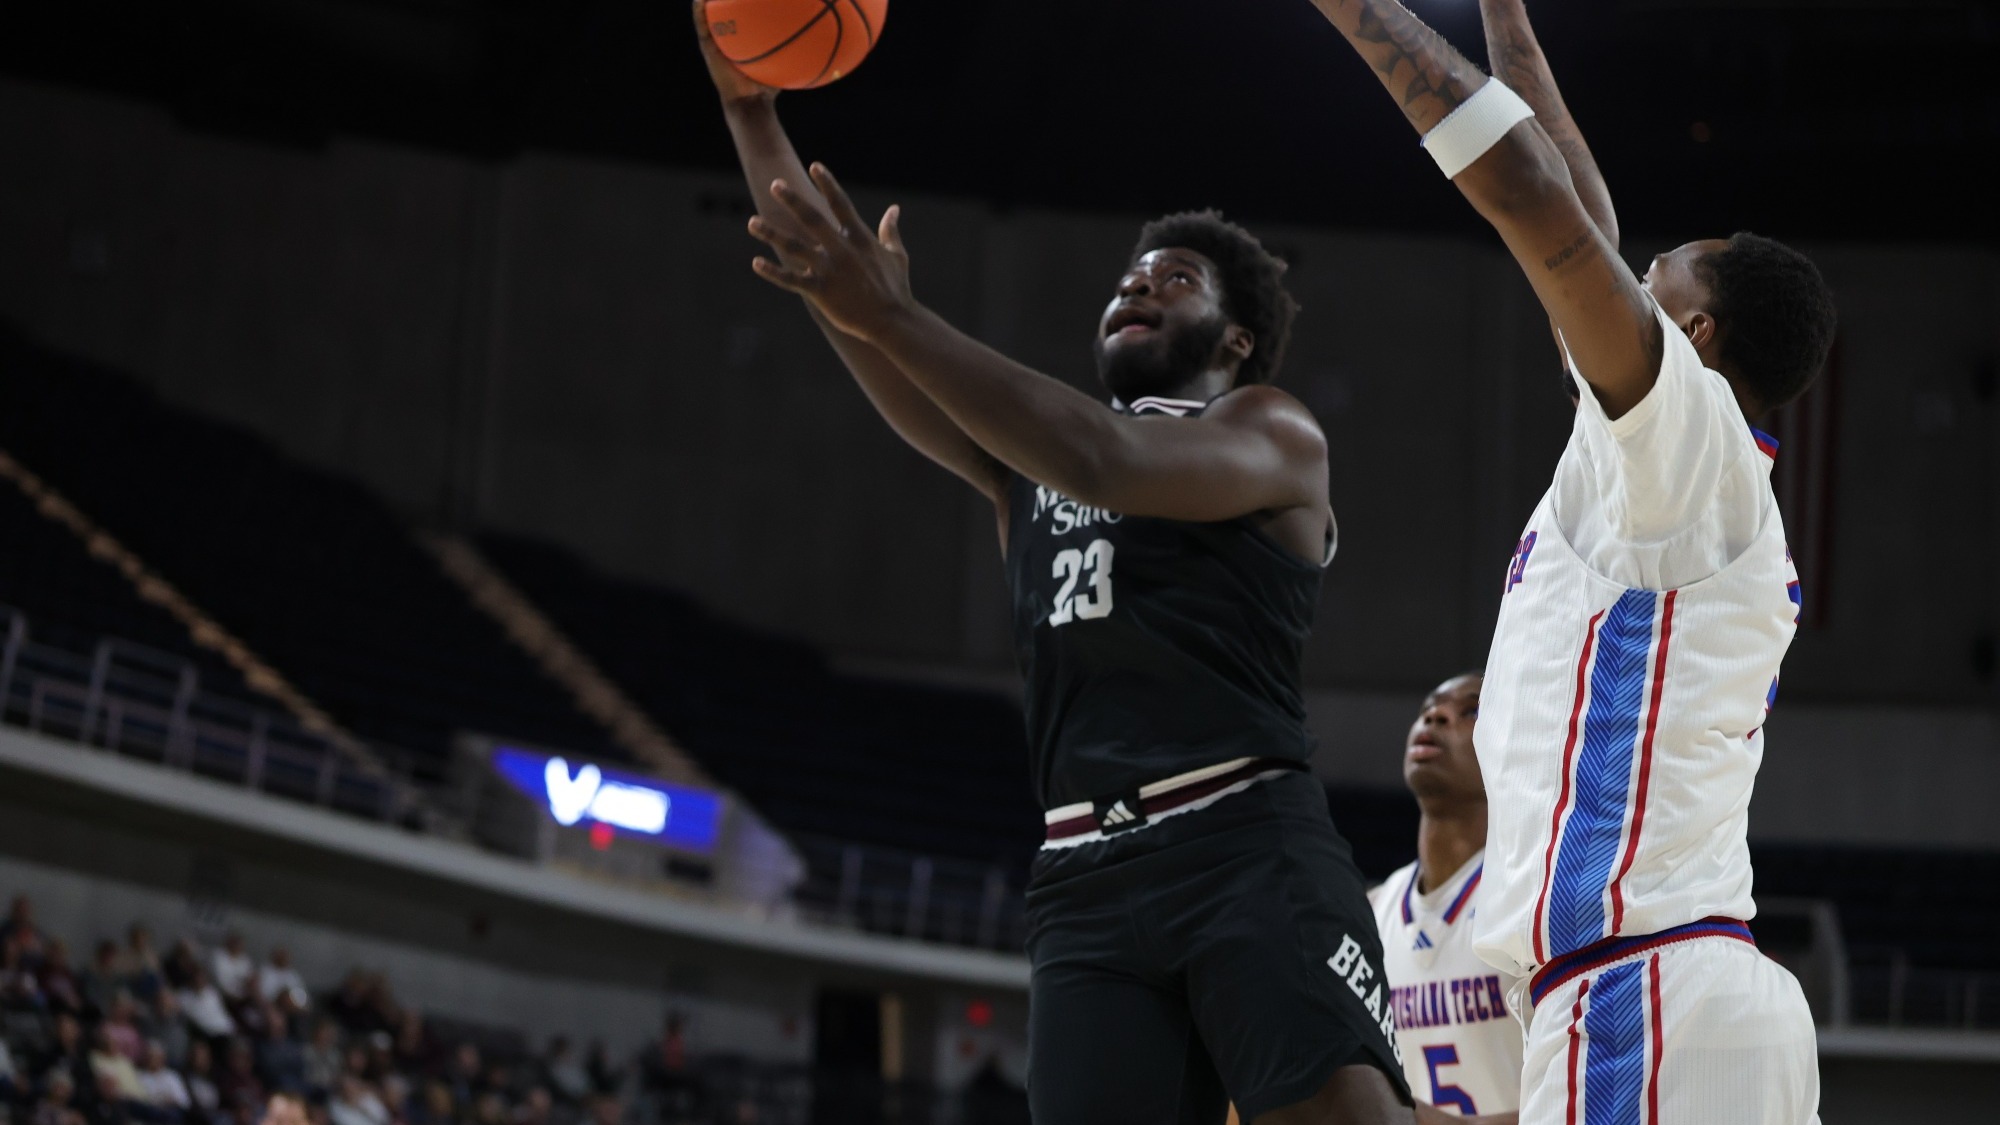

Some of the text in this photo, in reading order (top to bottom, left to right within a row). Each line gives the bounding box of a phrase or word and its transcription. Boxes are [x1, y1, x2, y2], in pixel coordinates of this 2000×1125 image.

[1049, 538, 1115, 627] 23
[1451, 974, 1508, 1024] TECH
[1422, 1044, 1477, 1115] 5
